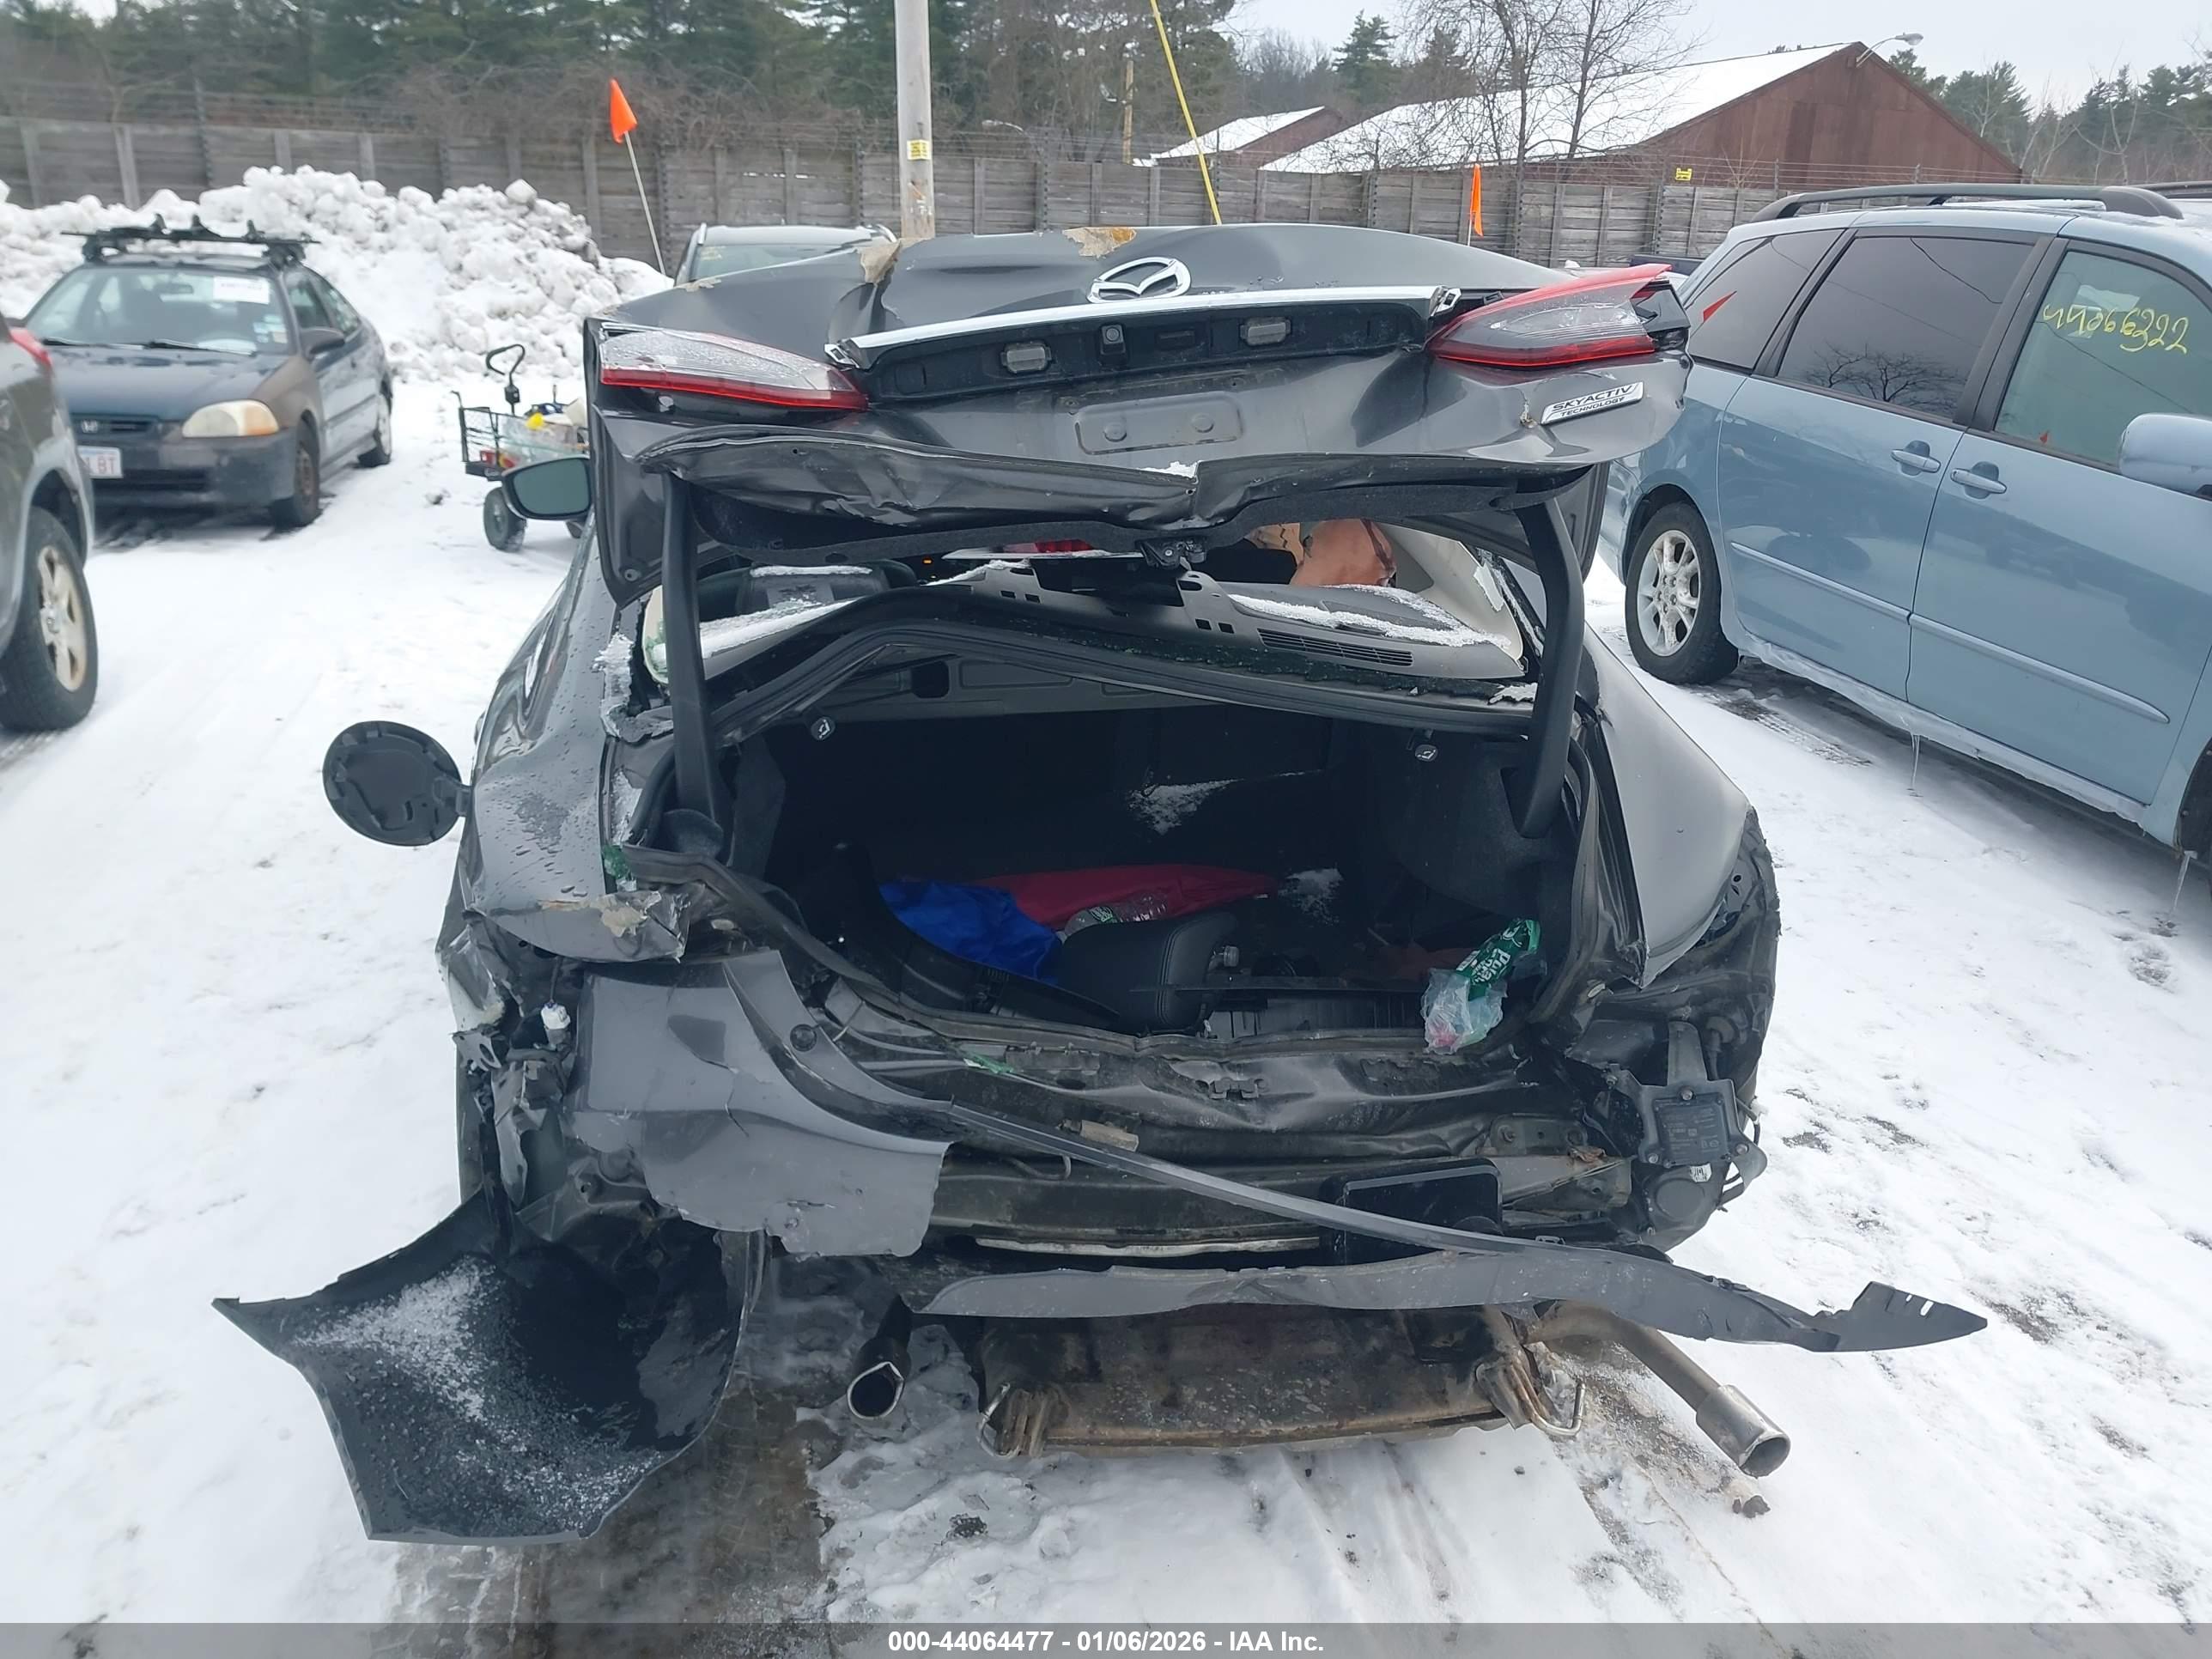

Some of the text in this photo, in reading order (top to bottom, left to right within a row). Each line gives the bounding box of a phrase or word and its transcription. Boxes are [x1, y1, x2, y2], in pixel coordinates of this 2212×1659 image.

[2043, 303, 2189, 355] 44066322
[1553, 385, 1632, 410] SKYACTIV
[1560, 396, 1626, 417] TECHNOLOGY
